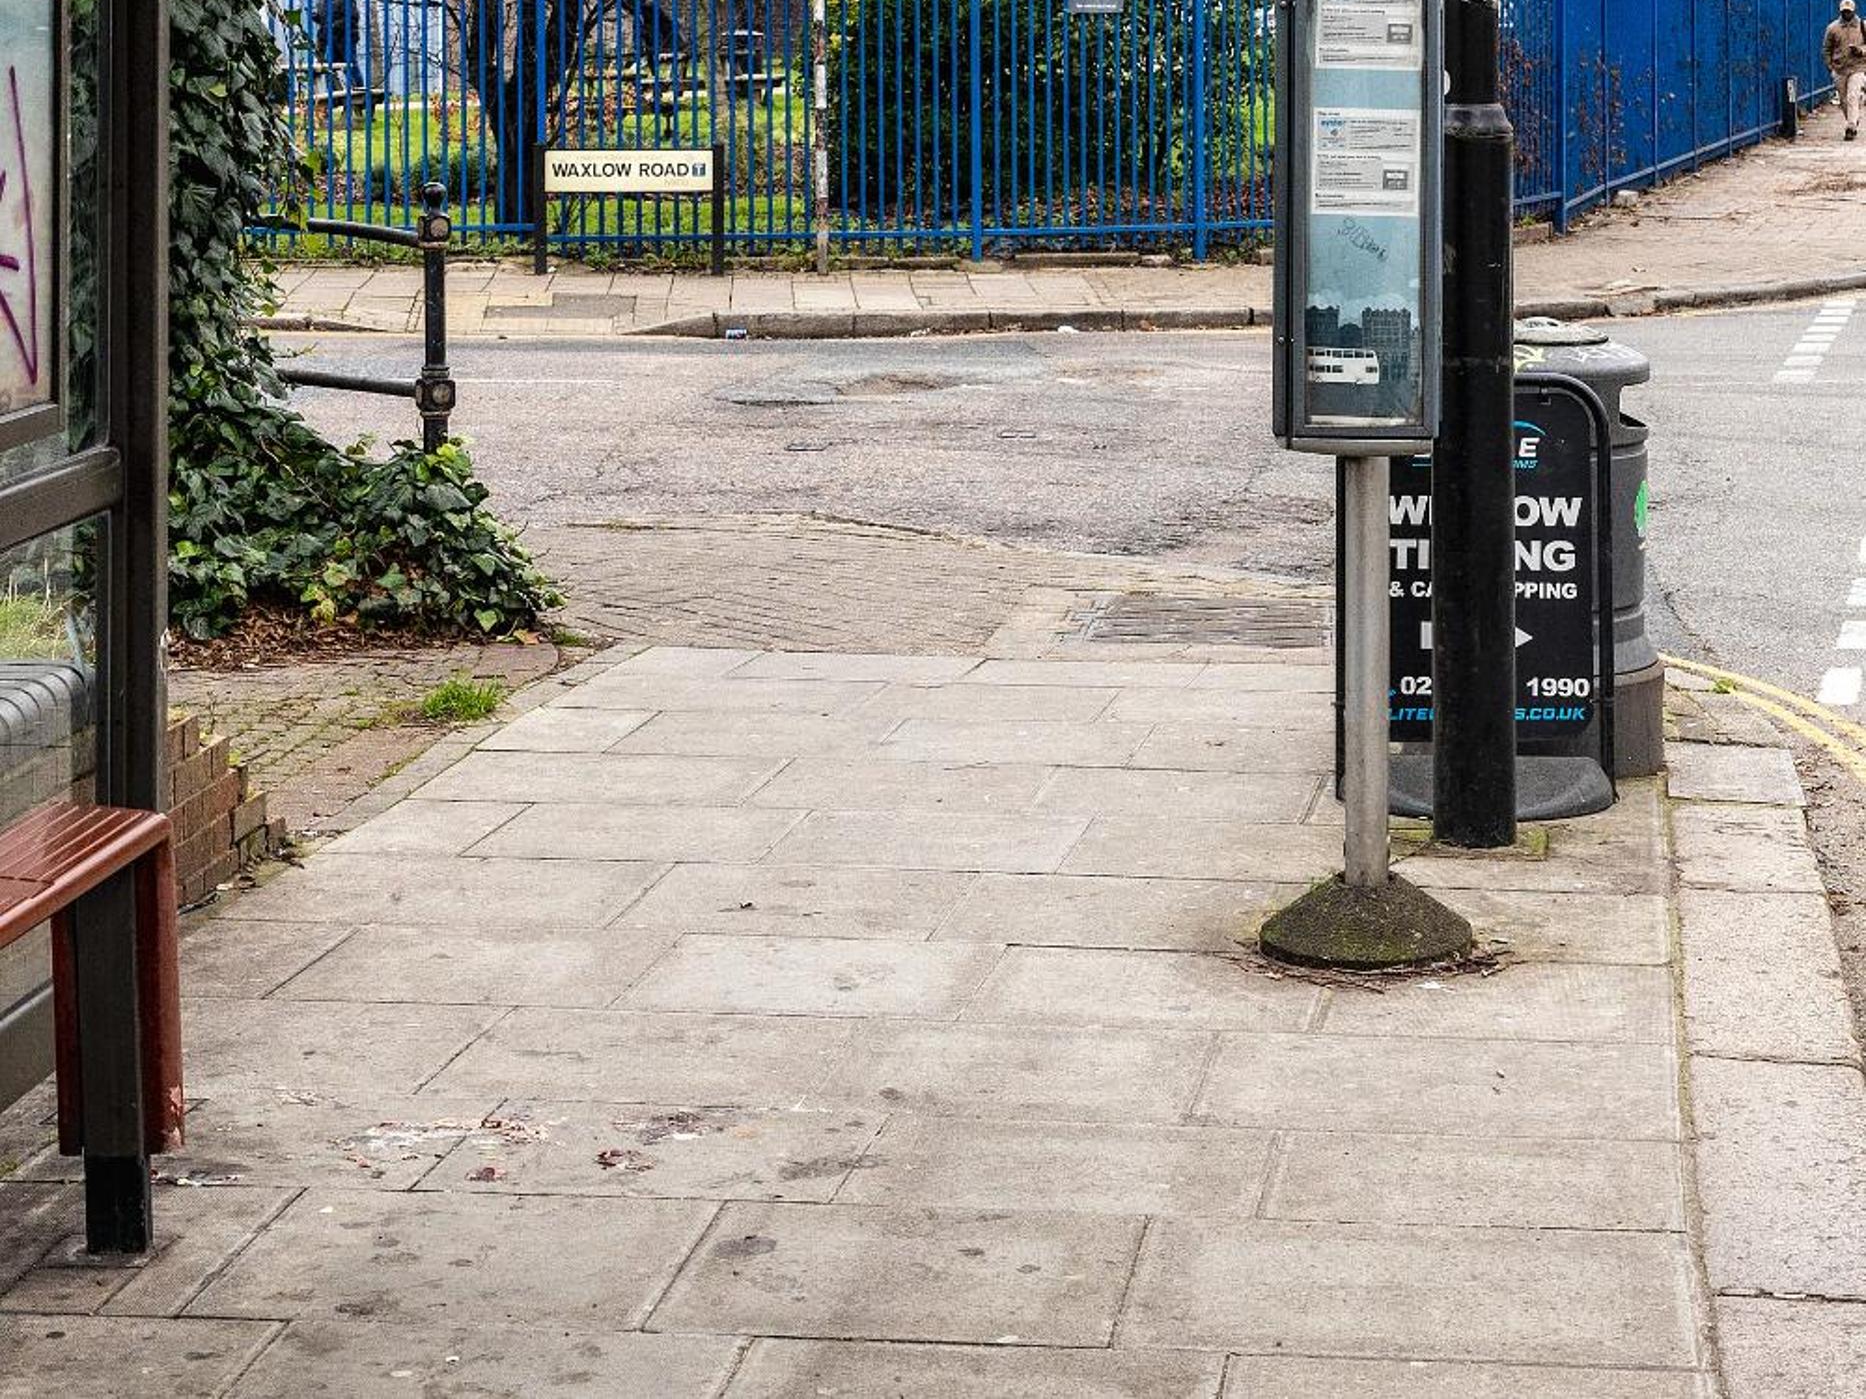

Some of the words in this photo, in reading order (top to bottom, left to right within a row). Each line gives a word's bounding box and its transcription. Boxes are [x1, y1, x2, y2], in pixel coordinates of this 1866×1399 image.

[552, 163, 632, 177] WAXLOW
[639, 163, 689, 177] ROAD
[1389, 581, 1405, 598] &
[1400, 676, 1433, 695] 02
[1525, 677, 1590, 697] 1990
